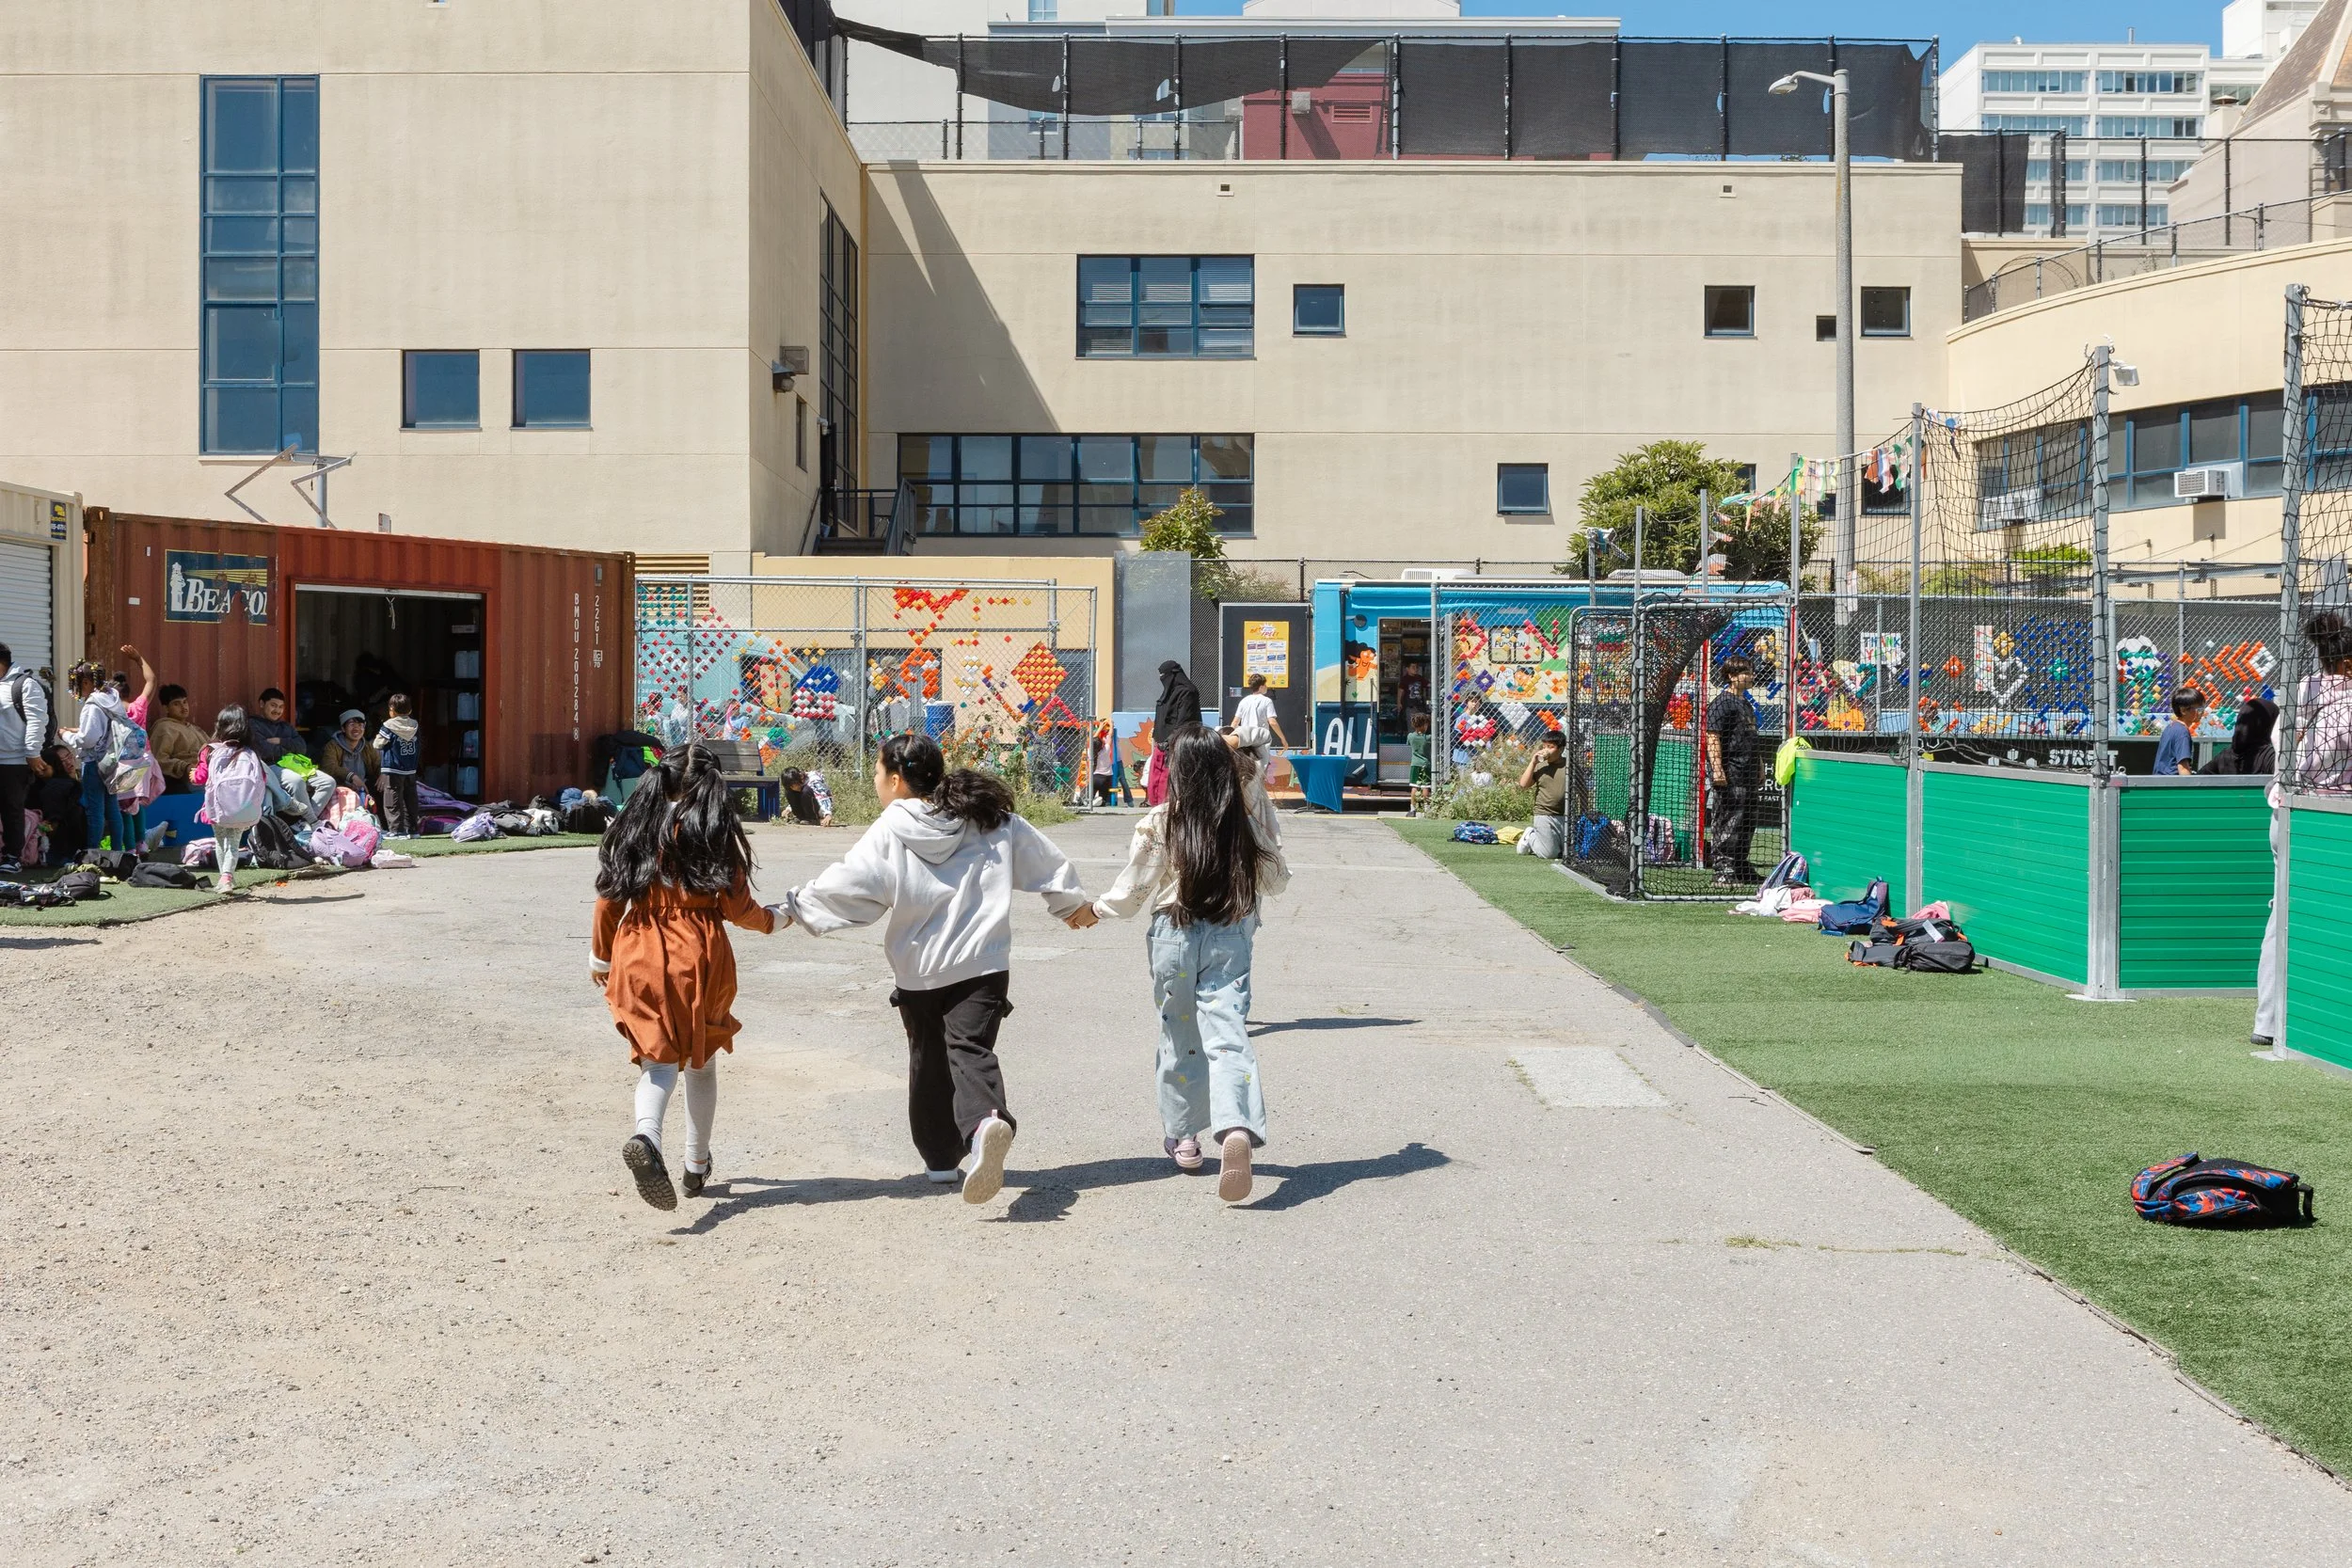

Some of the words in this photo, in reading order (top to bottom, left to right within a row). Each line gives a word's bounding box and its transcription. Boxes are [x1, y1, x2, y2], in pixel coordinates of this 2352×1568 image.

[1324, 718, 1377, 759] ALL
[401, 741, 415, 755] 23
[2048, 749, 2119, 767] STRET
